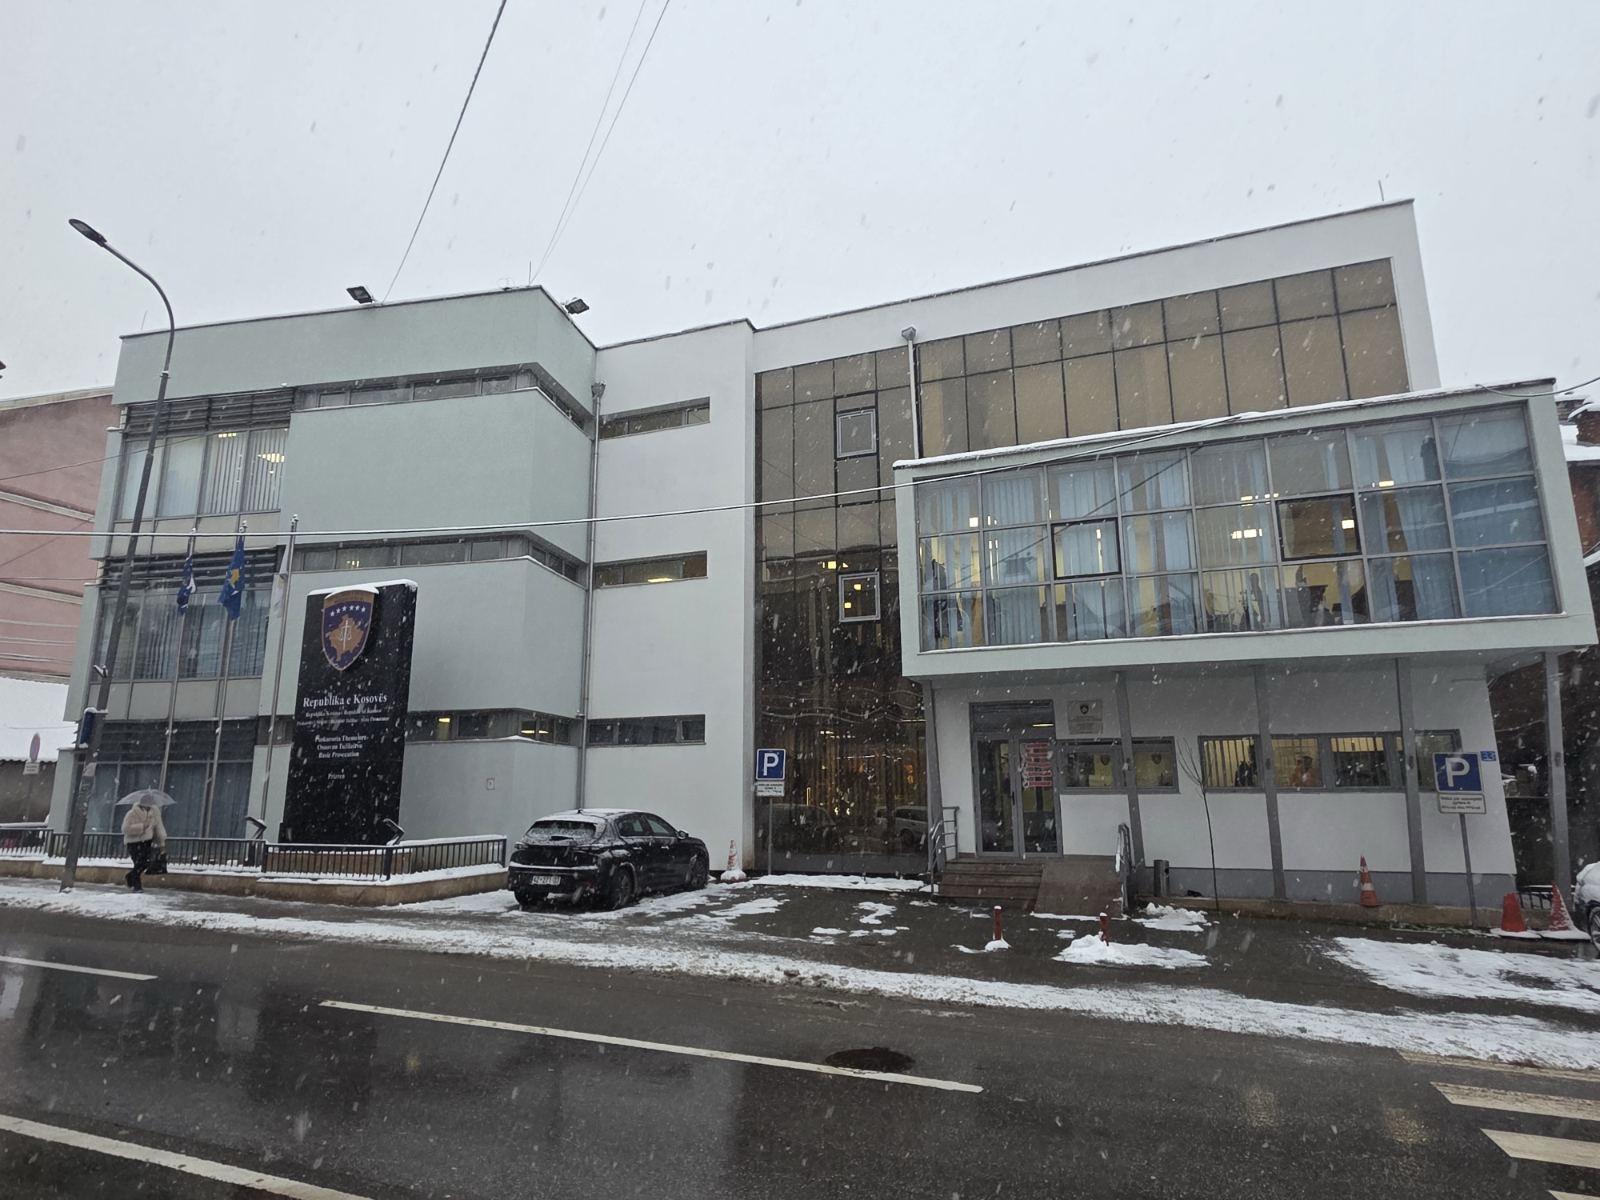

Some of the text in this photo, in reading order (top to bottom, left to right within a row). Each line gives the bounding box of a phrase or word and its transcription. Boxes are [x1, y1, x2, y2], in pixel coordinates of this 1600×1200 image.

[303, 693, 388, 709] Republika e Kosovës
[763, 752, 779, 776] P
[1445, 757, 1470, 787] P
